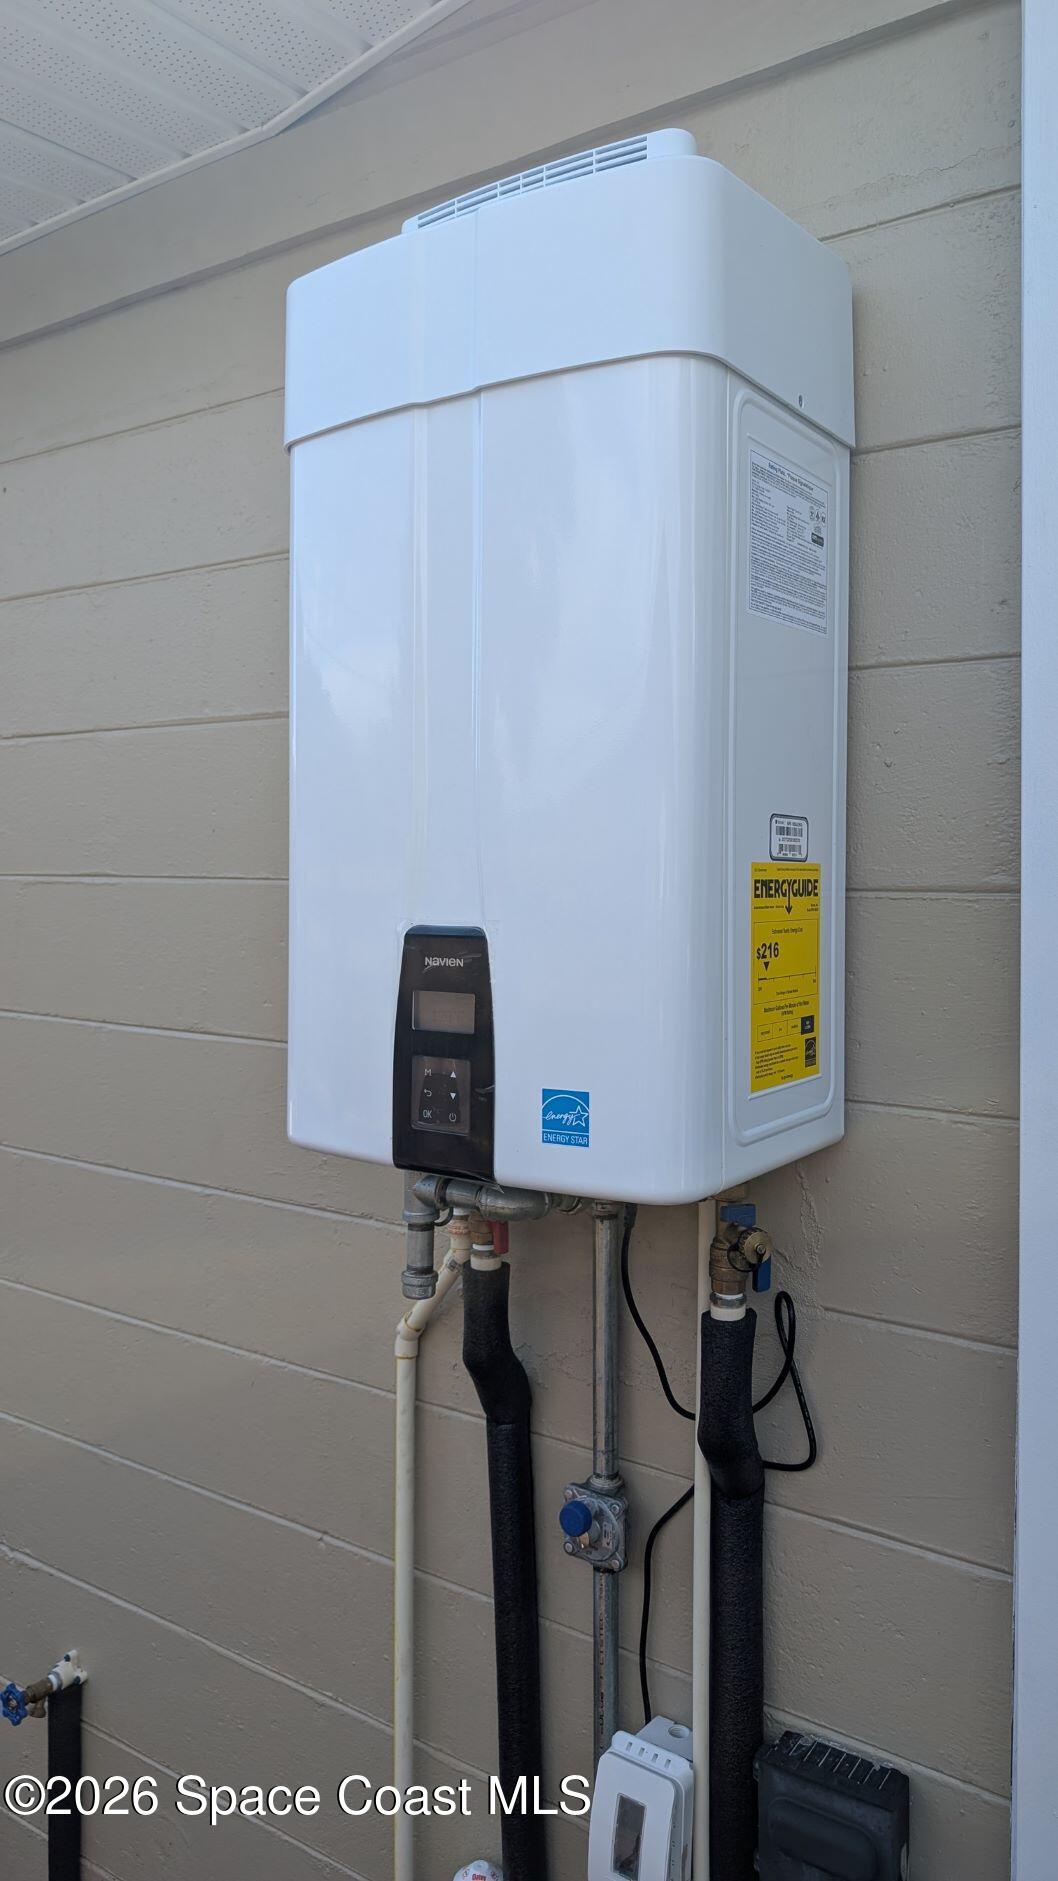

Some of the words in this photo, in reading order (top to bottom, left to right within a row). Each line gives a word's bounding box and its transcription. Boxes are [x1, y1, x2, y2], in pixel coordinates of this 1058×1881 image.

[754, 878, 819, 898] ENERGYGUIDE
[756, 941, 780, 960] $216
[424, 1068, 432, 1077] M
[422, 1109, 432, 1119] OK
[543, 1132, 570, 1144] ENERGY
[570, 1135, 588, 1145] STAR
